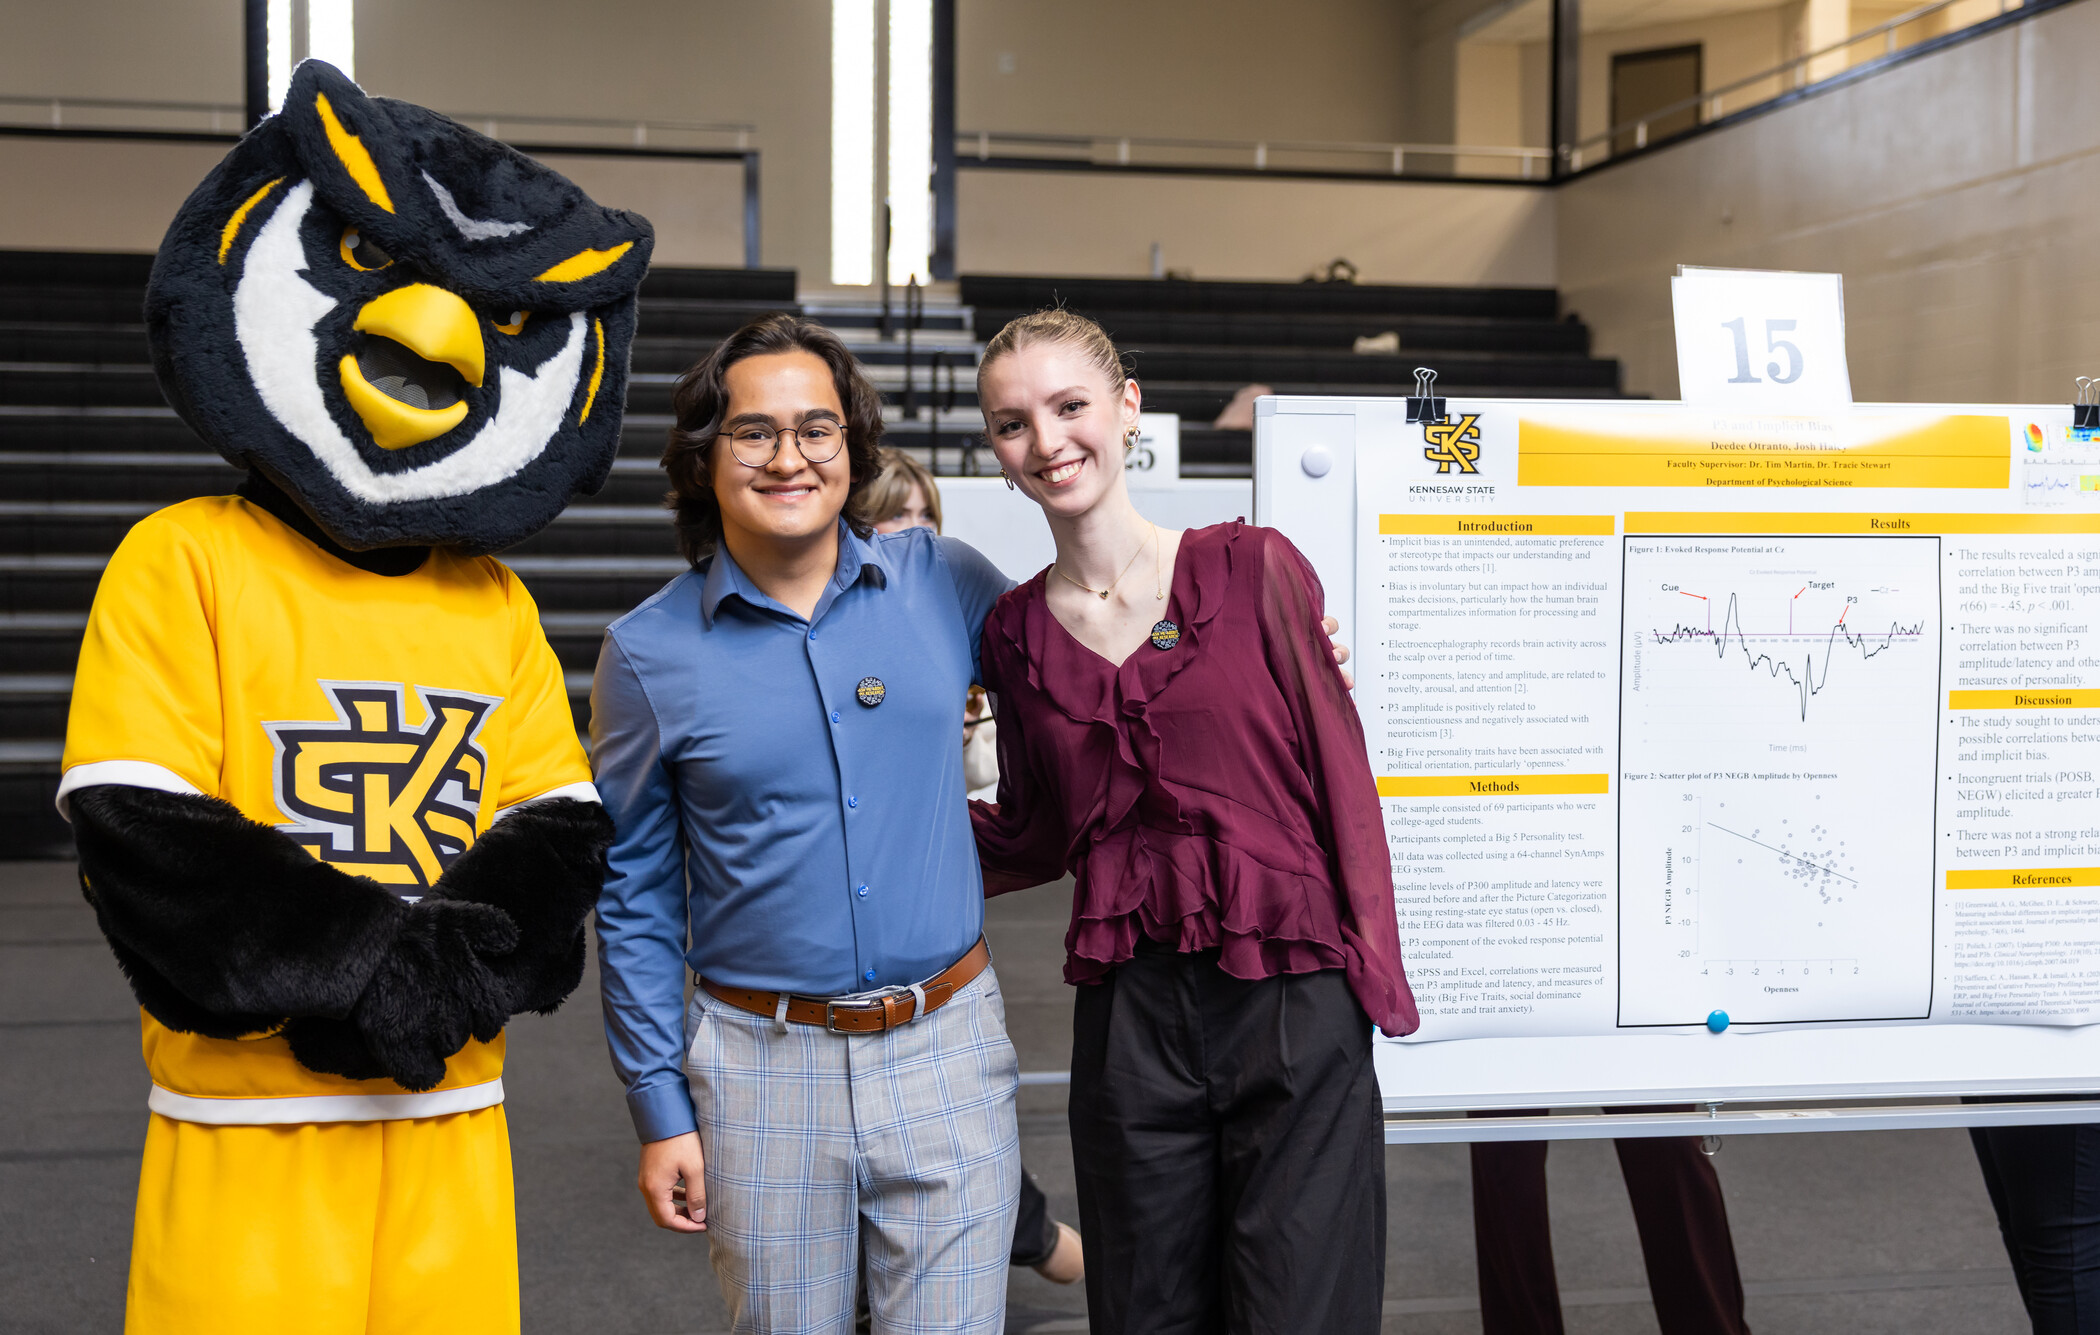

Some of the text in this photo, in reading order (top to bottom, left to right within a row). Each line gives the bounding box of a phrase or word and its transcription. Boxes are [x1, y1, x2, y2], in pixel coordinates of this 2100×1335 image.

[1721, 316, 1804, 384] 15
[1749, 443, 1791, 452] Otranto,
[1666, 460, 1698, 469] Faculty
[1699, 460, 1747, 470] Supervisor:
[1783, 461, 1815, 469] Martin,
[1706, 479, 1755, 488] Department
[1757, 478, 1765, 486] of
[1767, 478, 1821, 488] Psychological
[1409, 486, 1495, 494] KENNESAW STATE
[1457, 521, 1533, 531] Introduction
[1870, 518, 1911, 529] Results
[1389, 538, 1422, 547] Implicit
[1464, 538, 1513, 547] unintended,
[1516, 538, 1557, 546] automatic
[1560, 538, 1604, 548] preference
[1629, 546, 1654, 554] Figure
[1420, 563, 1453, 571] towards
[1482, 564, 1497, 573] [1].
[1662, 584, 1680, 592] Cue
[1808, 581, 1835, 590] Target
[1847, 596, 1858, 604] P3
[1389, 608, 1596, 618] compartmentalizes information for processing and
[1389, 622, 1422, 631] storage.
[1960, 623, 1991, 634] There
[1994, 626, 2015, 634] was
[2033, 623, 2089, 636] significant
[1389, 640, 1488, 650] Electroencephalography
[1546, 640, 1578, 649] activity
[1960, 640, 2080, 651] correlation between P3
[1633, 650, 1642, 692] Amplitude
[2011, 674, 2022, 685] of
[2025, 674, 2086, 687] personality.
[1388, 684, 1529, 695] novelty, arousal, and attention [2].
[2014, 695, 2072, 705] Discussion
[1389, 716, 1462, 724] conscientiousness
[1465, 716, 1480, 724] and
[1481, 715, 1524, 725] negatively
[1526, 715, 1569, 723] associated
[1388, 729, 1455, 738] neuroticism [3].
[1768, 744, 1807, 753] Time (ms)
[1958, 750, 2051, 763] and implicit bias.
[1623, 773, 1648, 781] Figure
[1687, 773, 1702, 781] plot
[1792, 773, 1802, 781] by
[1958, 771, 2096, 786] Incongruent trials (POSB,
[1469, 781, 1520, 792] Methods
[1391, 804, 1407, 812] The
[1411, 804, 1440, 814] sample
[1442, 804, 1481, 812] consisted
[1483, 803, 1492, 811] of
[1494, 803, 1505, 811] 69
[1506, 803, 1554, 813] participants
[1556, 802, 1574, 810] who
[1957, 807, 2014, 820] amplitude.
[1391, 817, 1484, 827] college-aged students.
[1682, 825, 1692, 833] 20
[1391, 835, 1440, 845] Participants
[1443, 834, 1486, 844] completed
[1495, 833, 1511, 843] Big
[1520, 832, 1566, 843] Personality
[1682, 856, 1692, 864] 10
[1414, 867, 1446, 875] system.
[1665, 848, 1673, 886] Amplitude
[2012, 874, 2072, 885] References
[1678, 918, 1691, 927] -10
[1677, 950, 1690, 958] -20
[1700, 968, 1710, 976] -4
[1725, 968, 1734, 976] -3
[1751, 968, 1760, 976] -2
[1854, 966, 1859, 974] 2
[1764, 986, 1799, 994] Openness
